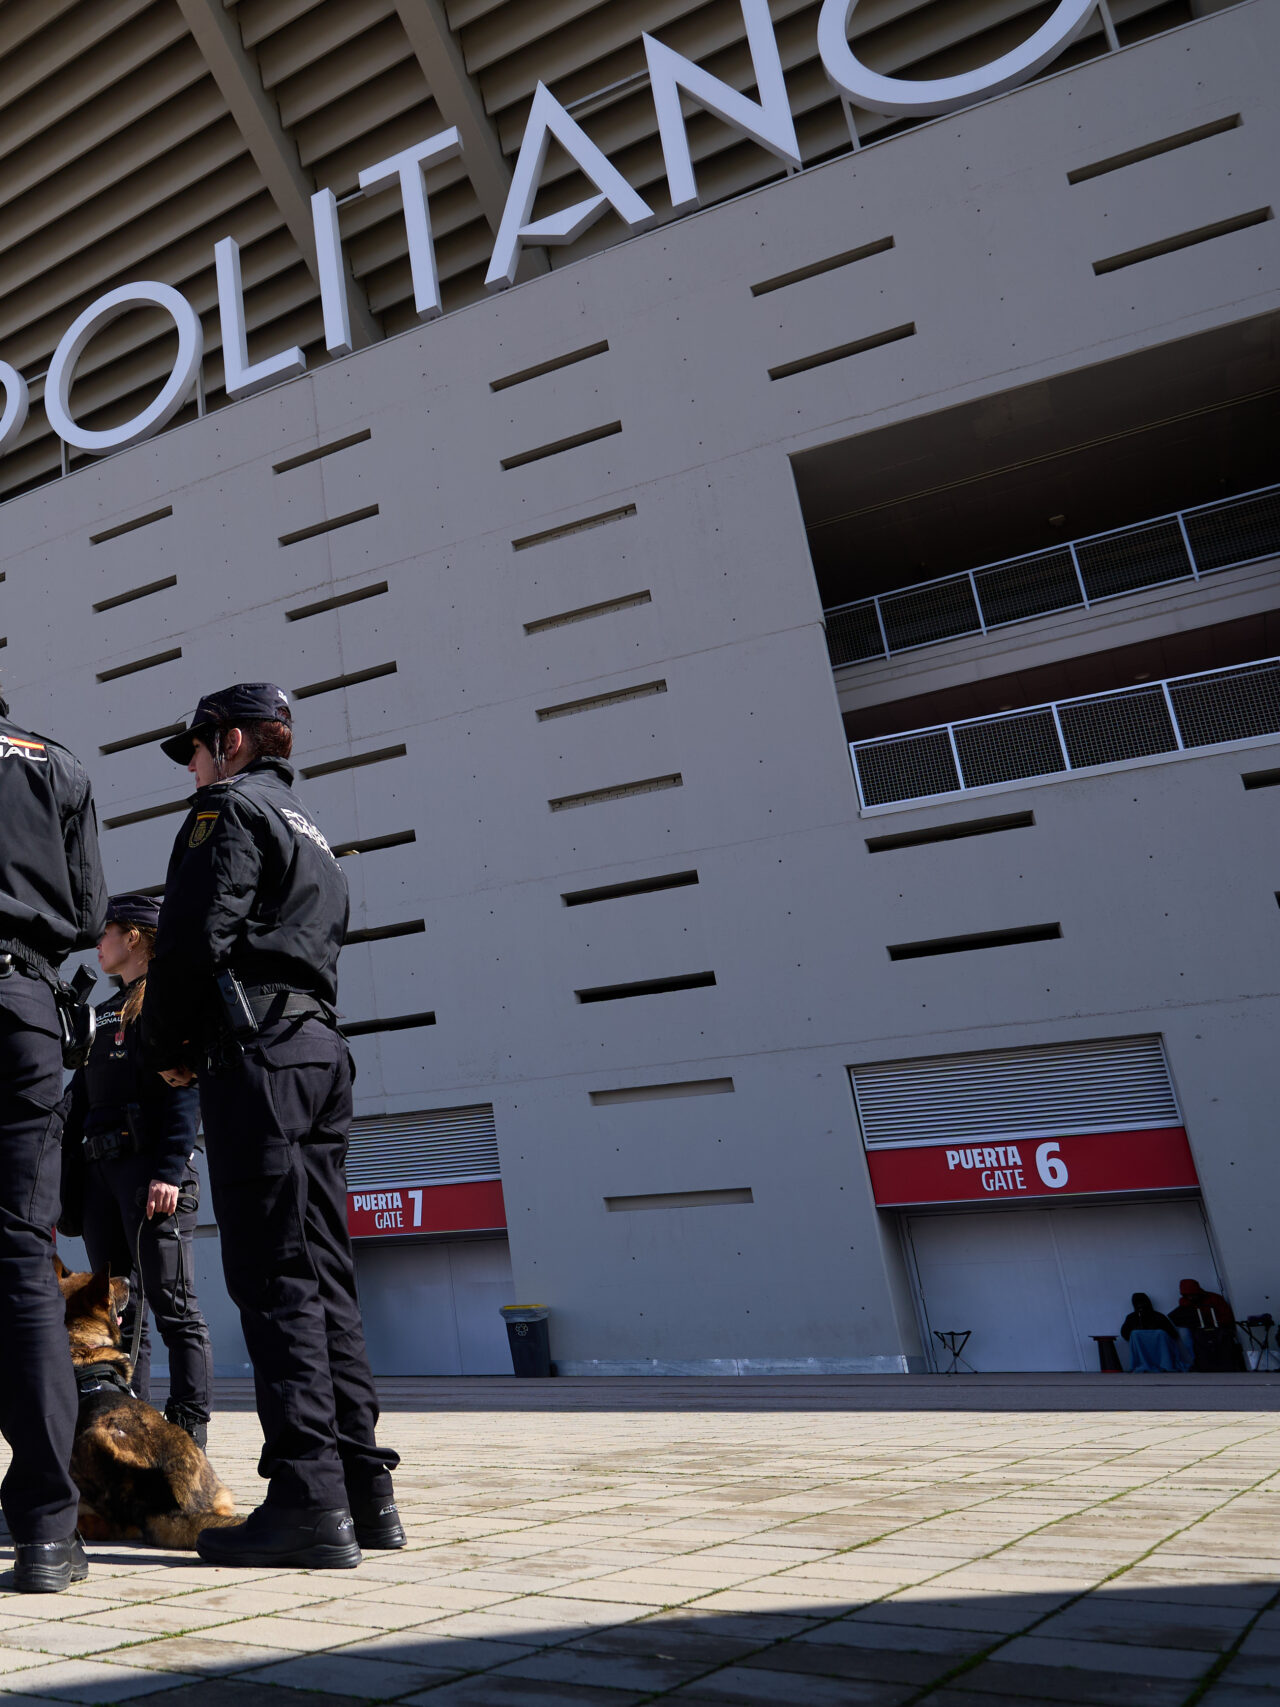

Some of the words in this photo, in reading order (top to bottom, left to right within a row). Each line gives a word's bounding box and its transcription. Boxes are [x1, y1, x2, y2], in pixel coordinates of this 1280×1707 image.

[945, 1145, 1023, 1171] PUERTA
[1035, 1141, 1069, 1189] 6
[981, 1169, 1027, 1191] GATE
[353, 1192, 403, 1212] PUERTA
[408, 1190, 423, 1227] 7
[375, 1211, 405, 1229] GATE
